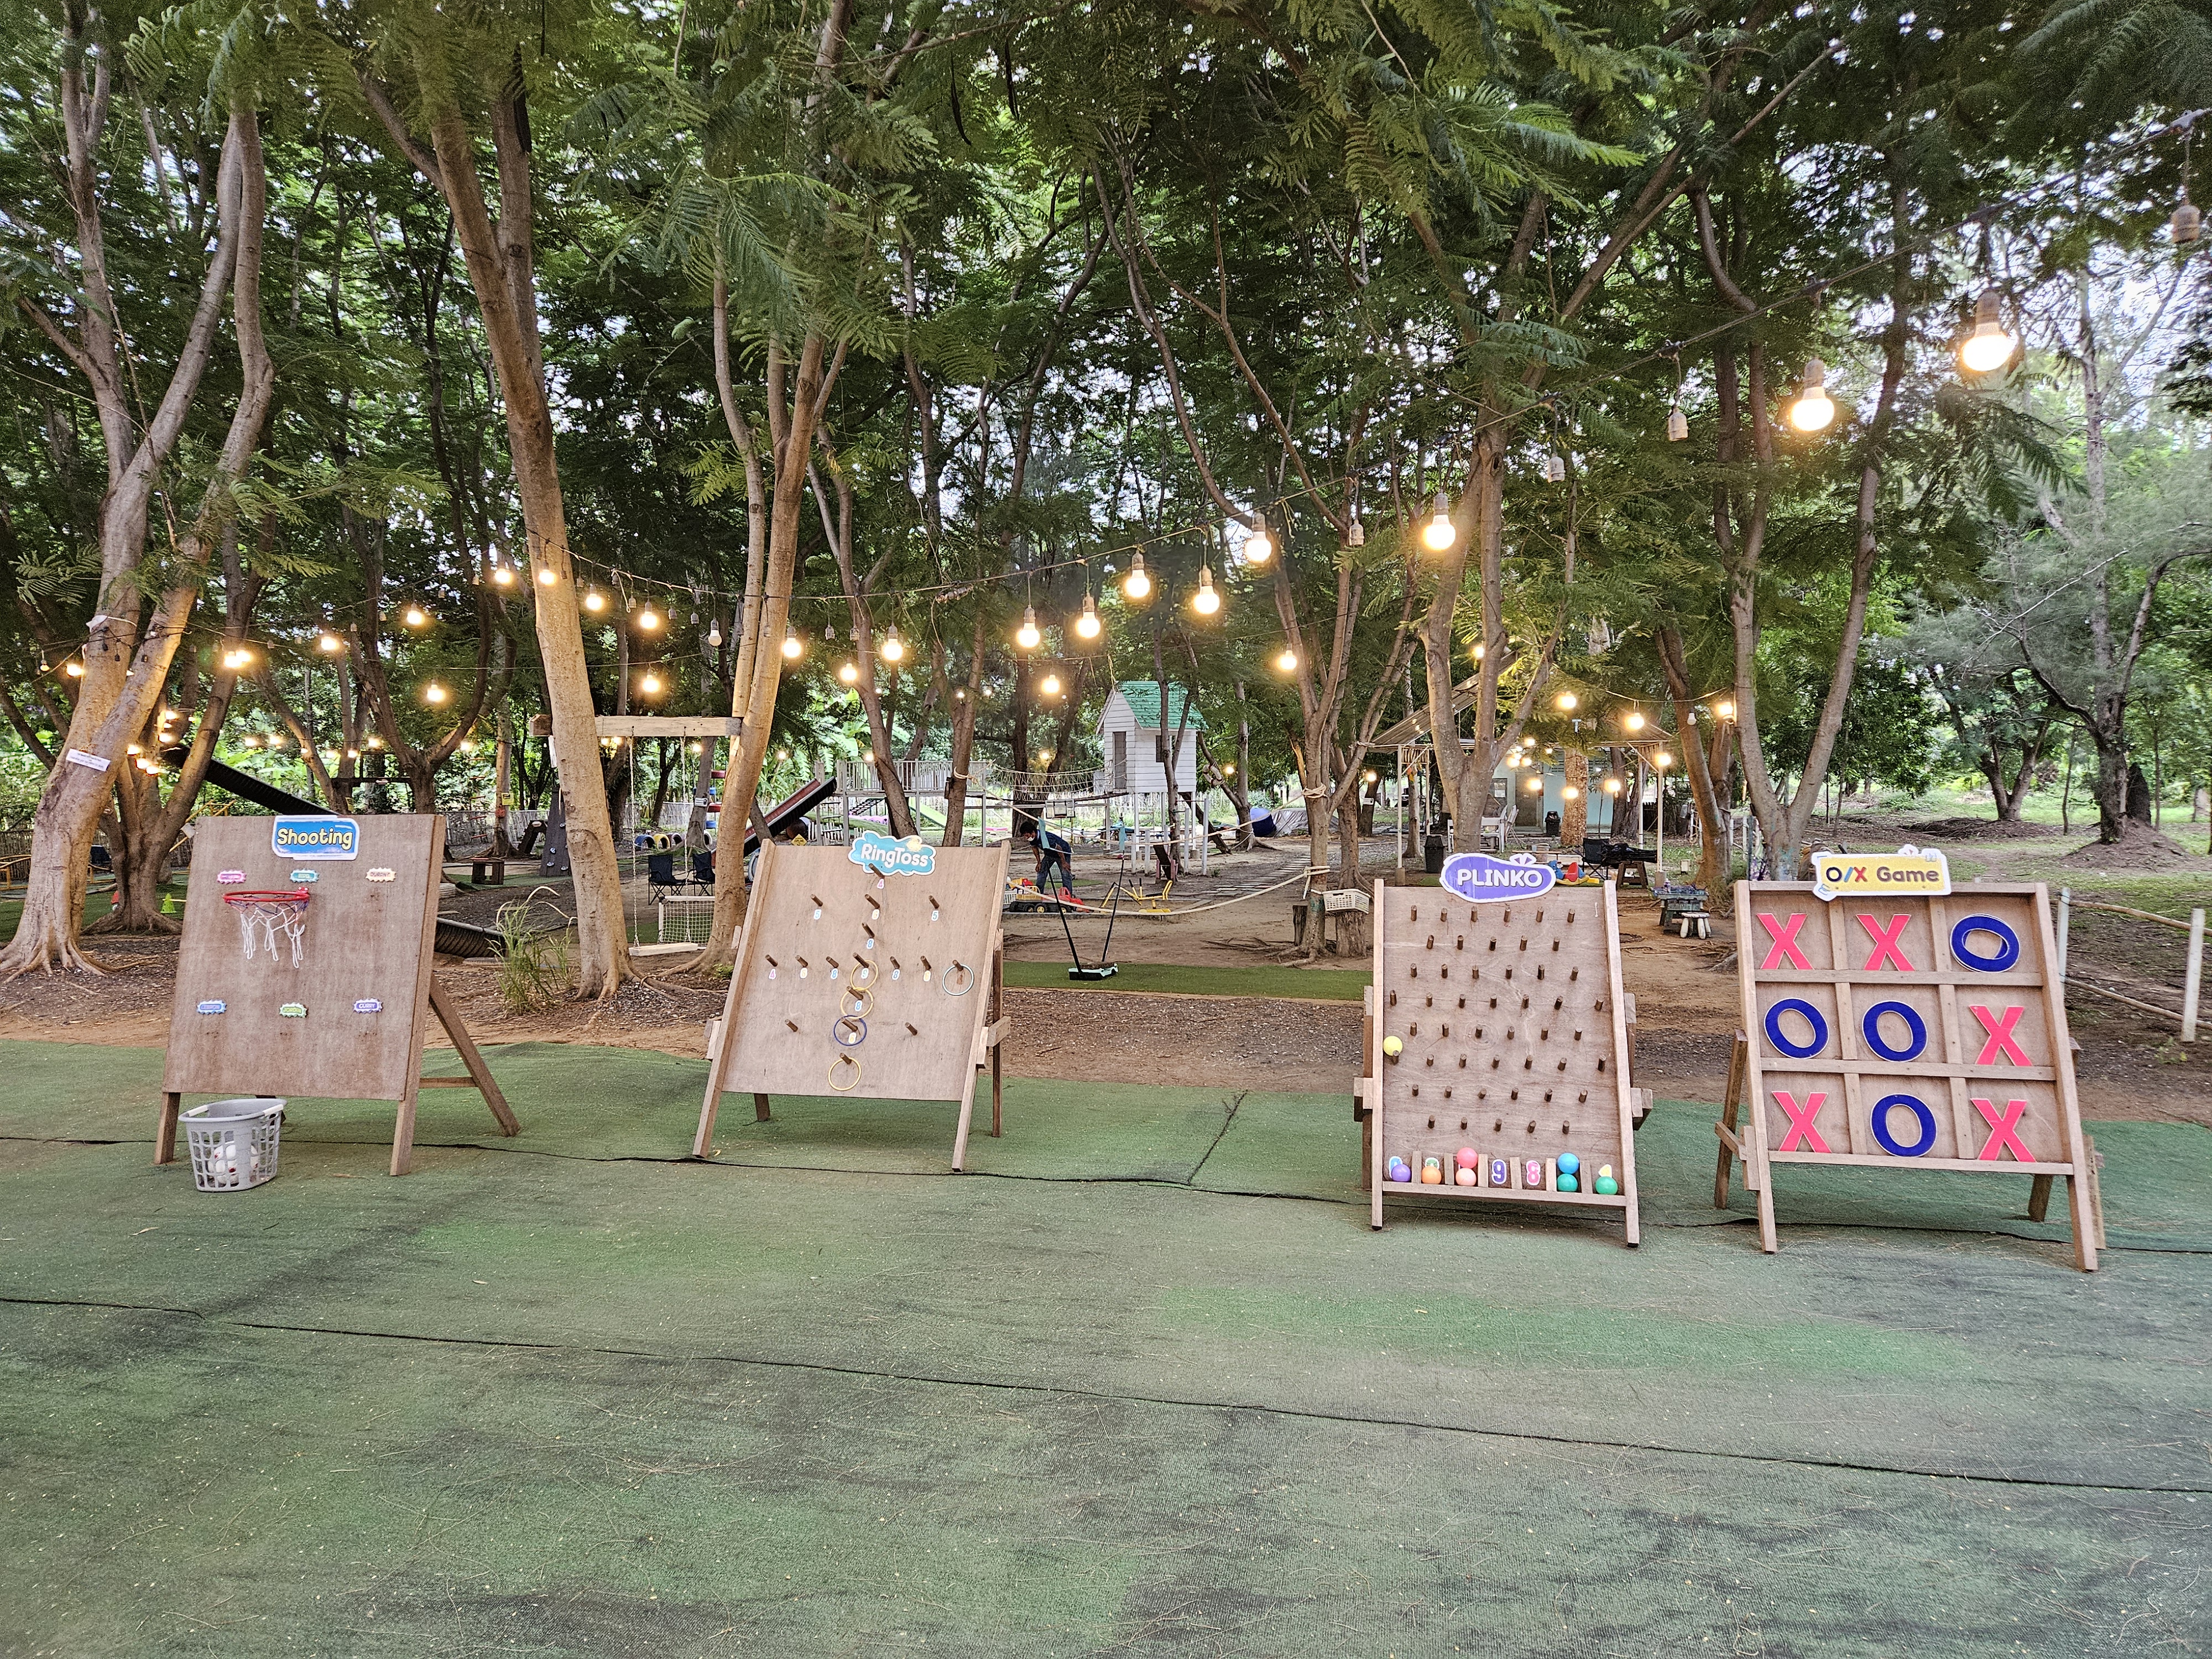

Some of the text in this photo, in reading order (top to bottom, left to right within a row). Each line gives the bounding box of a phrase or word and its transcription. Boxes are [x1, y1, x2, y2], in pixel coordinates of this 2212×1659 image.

[277, 827, 353, 851] Shooting
[860, 843, 929, 868] RingToss
[878, 879, 884, 888] 4
[1457, 869, 1543, 888] PLINKO
[1826, 867, 1939, 883] O/X Game
[814, 910, 821, 919] 5
[932, 911, 938, 921] 5
[867, 939, 874, 948] 8
[1756, 912, 2021, 973] X X O
[769, 969, 775, 979] 4
[831, 969, 838, 979] 8
[862, 968, 868, 978] 9
[893, 970, 899, 979] 8
[855, 1001, 862, 1011] 8
[1764, 997, 2033, 1066] O O X
[1772, 1091, 2037, 1162] X O X
[1492, 1160, 1540, 1185] 9 8
